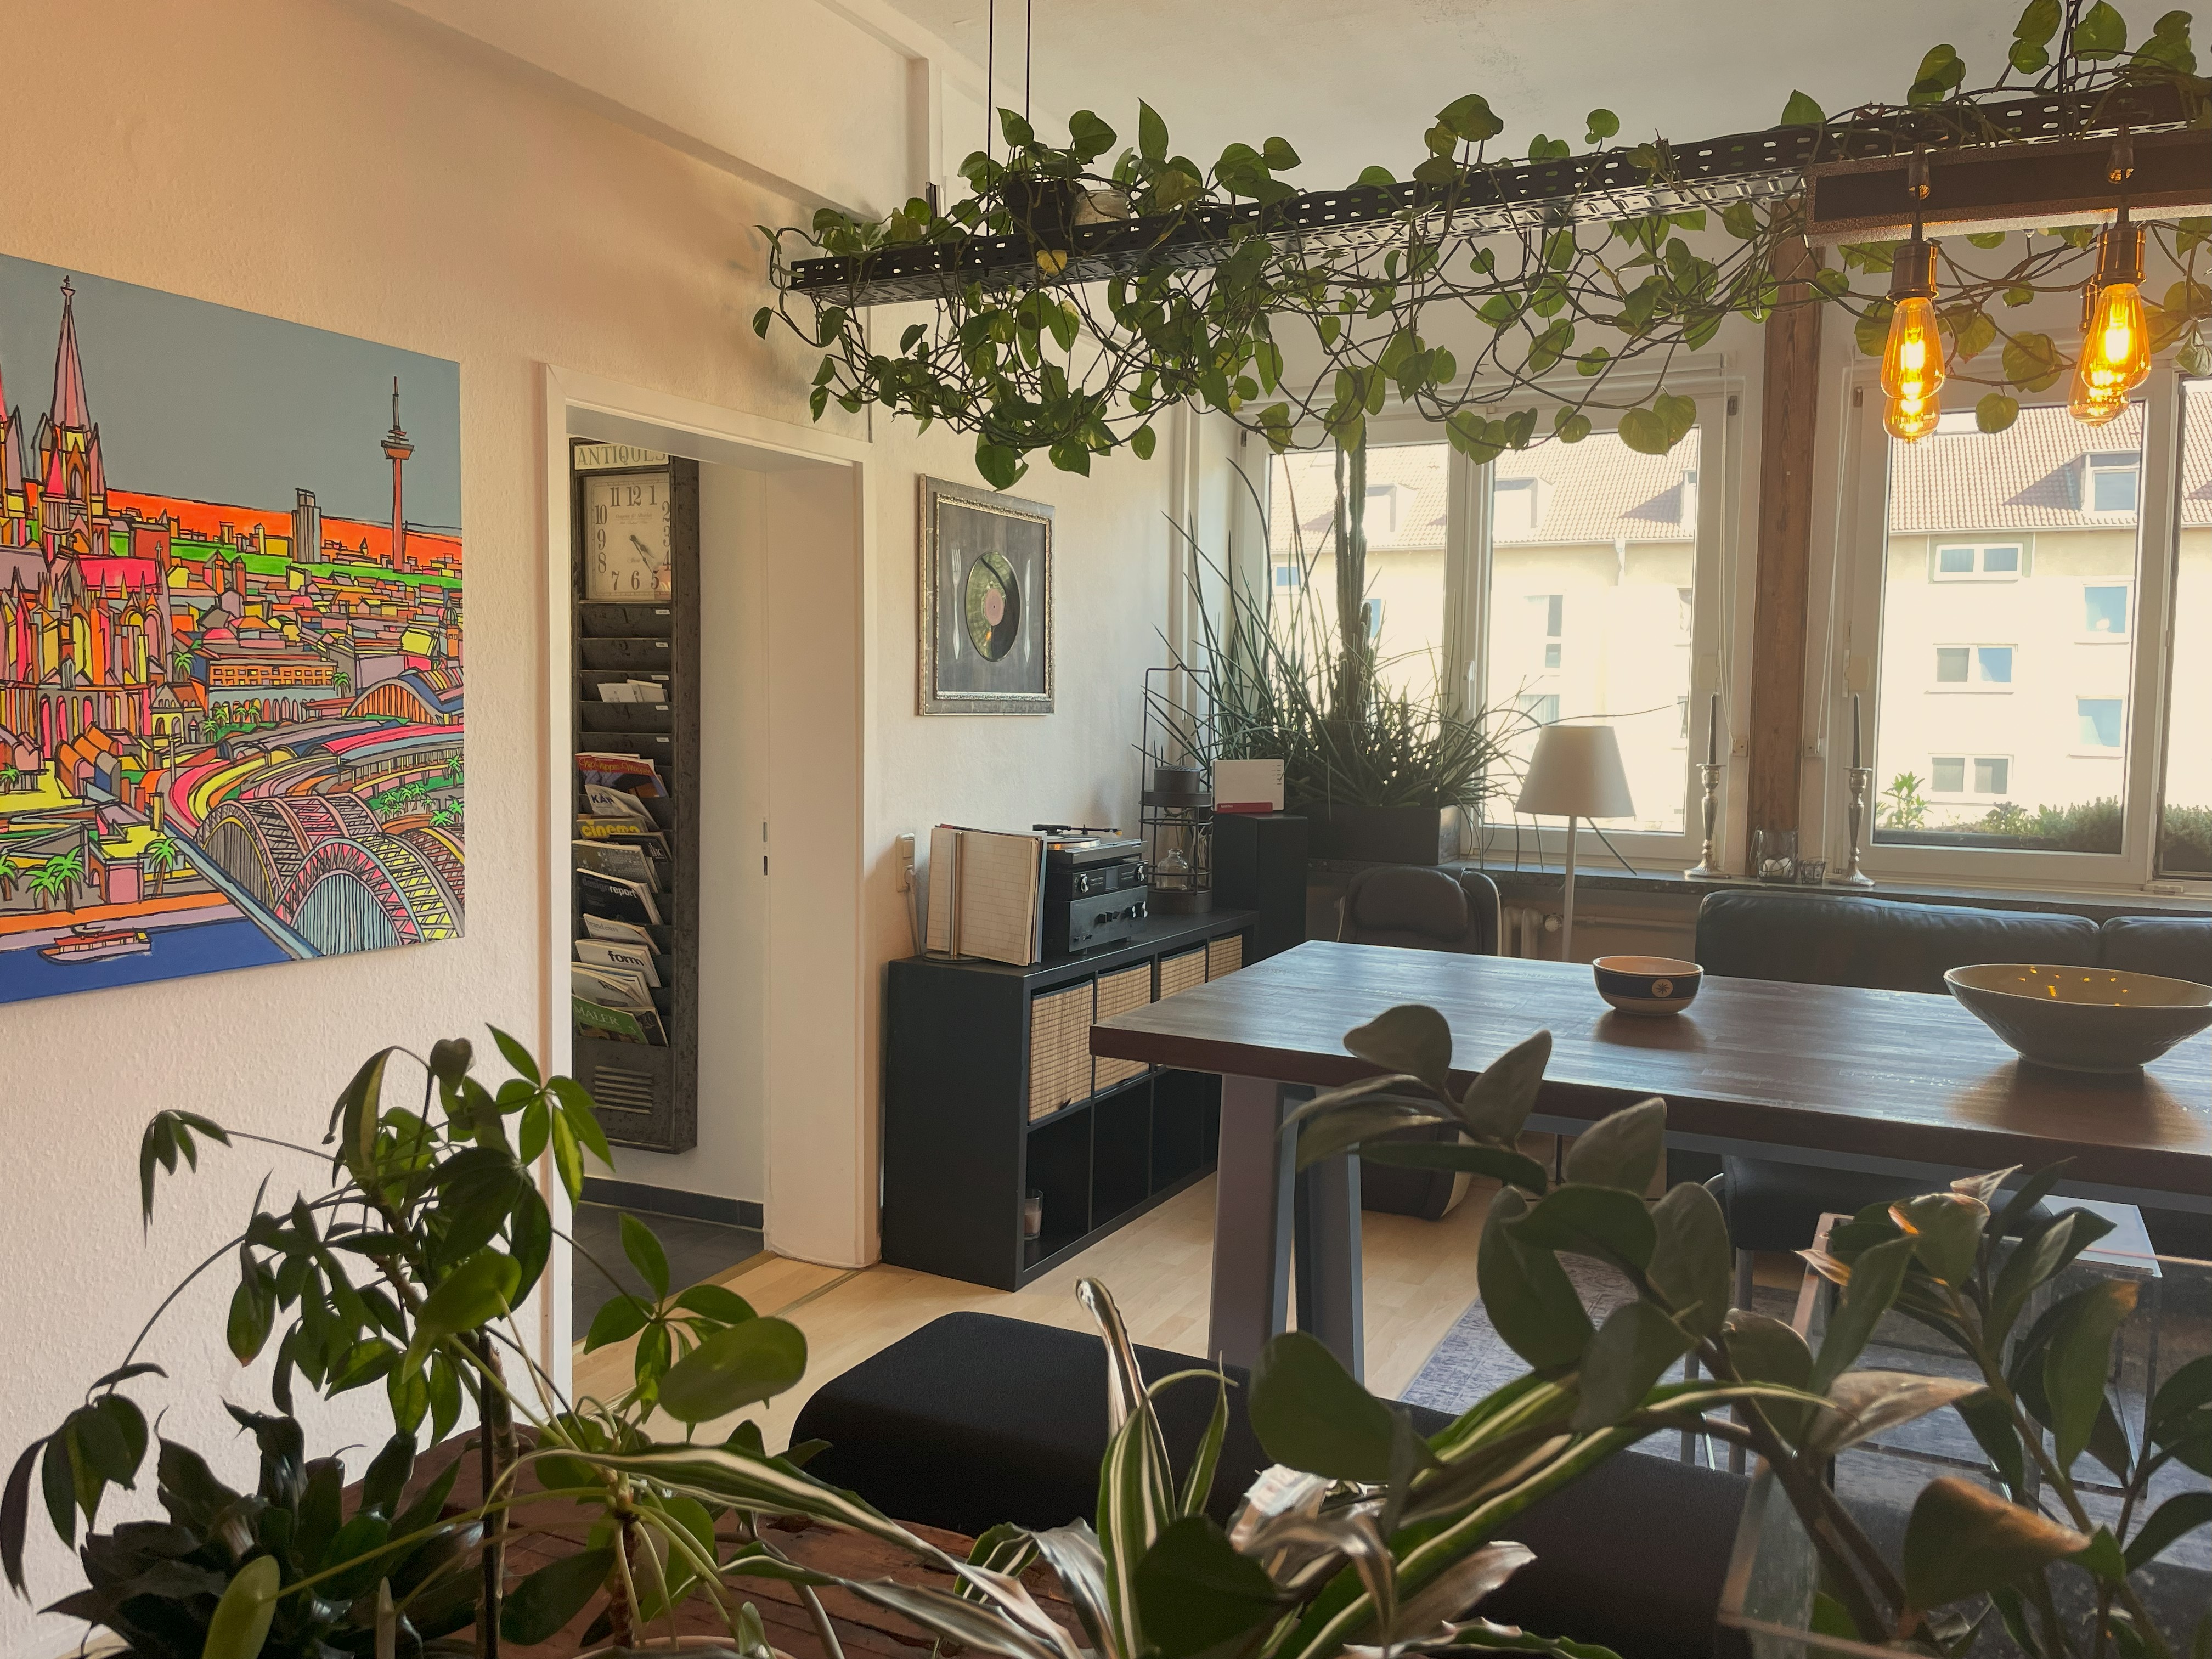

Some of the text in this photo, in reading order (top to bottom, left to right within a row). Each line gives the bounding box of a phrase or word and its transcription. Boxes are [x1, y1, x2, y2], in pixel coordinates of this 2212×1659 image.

[610, 485, 658, 507] 11 12 1
[595, 504, 608, 525] 10
[662, 501, 670, 522] 2
[597, 529, 606, 550] 9
[663, 526, 671, 547] 3
[598, 552, 607, 573] 8
[663, 550, 672, 571] 4
[611, 569, 659, 591] 7 6 5
[607, 950, 644, 966] form
